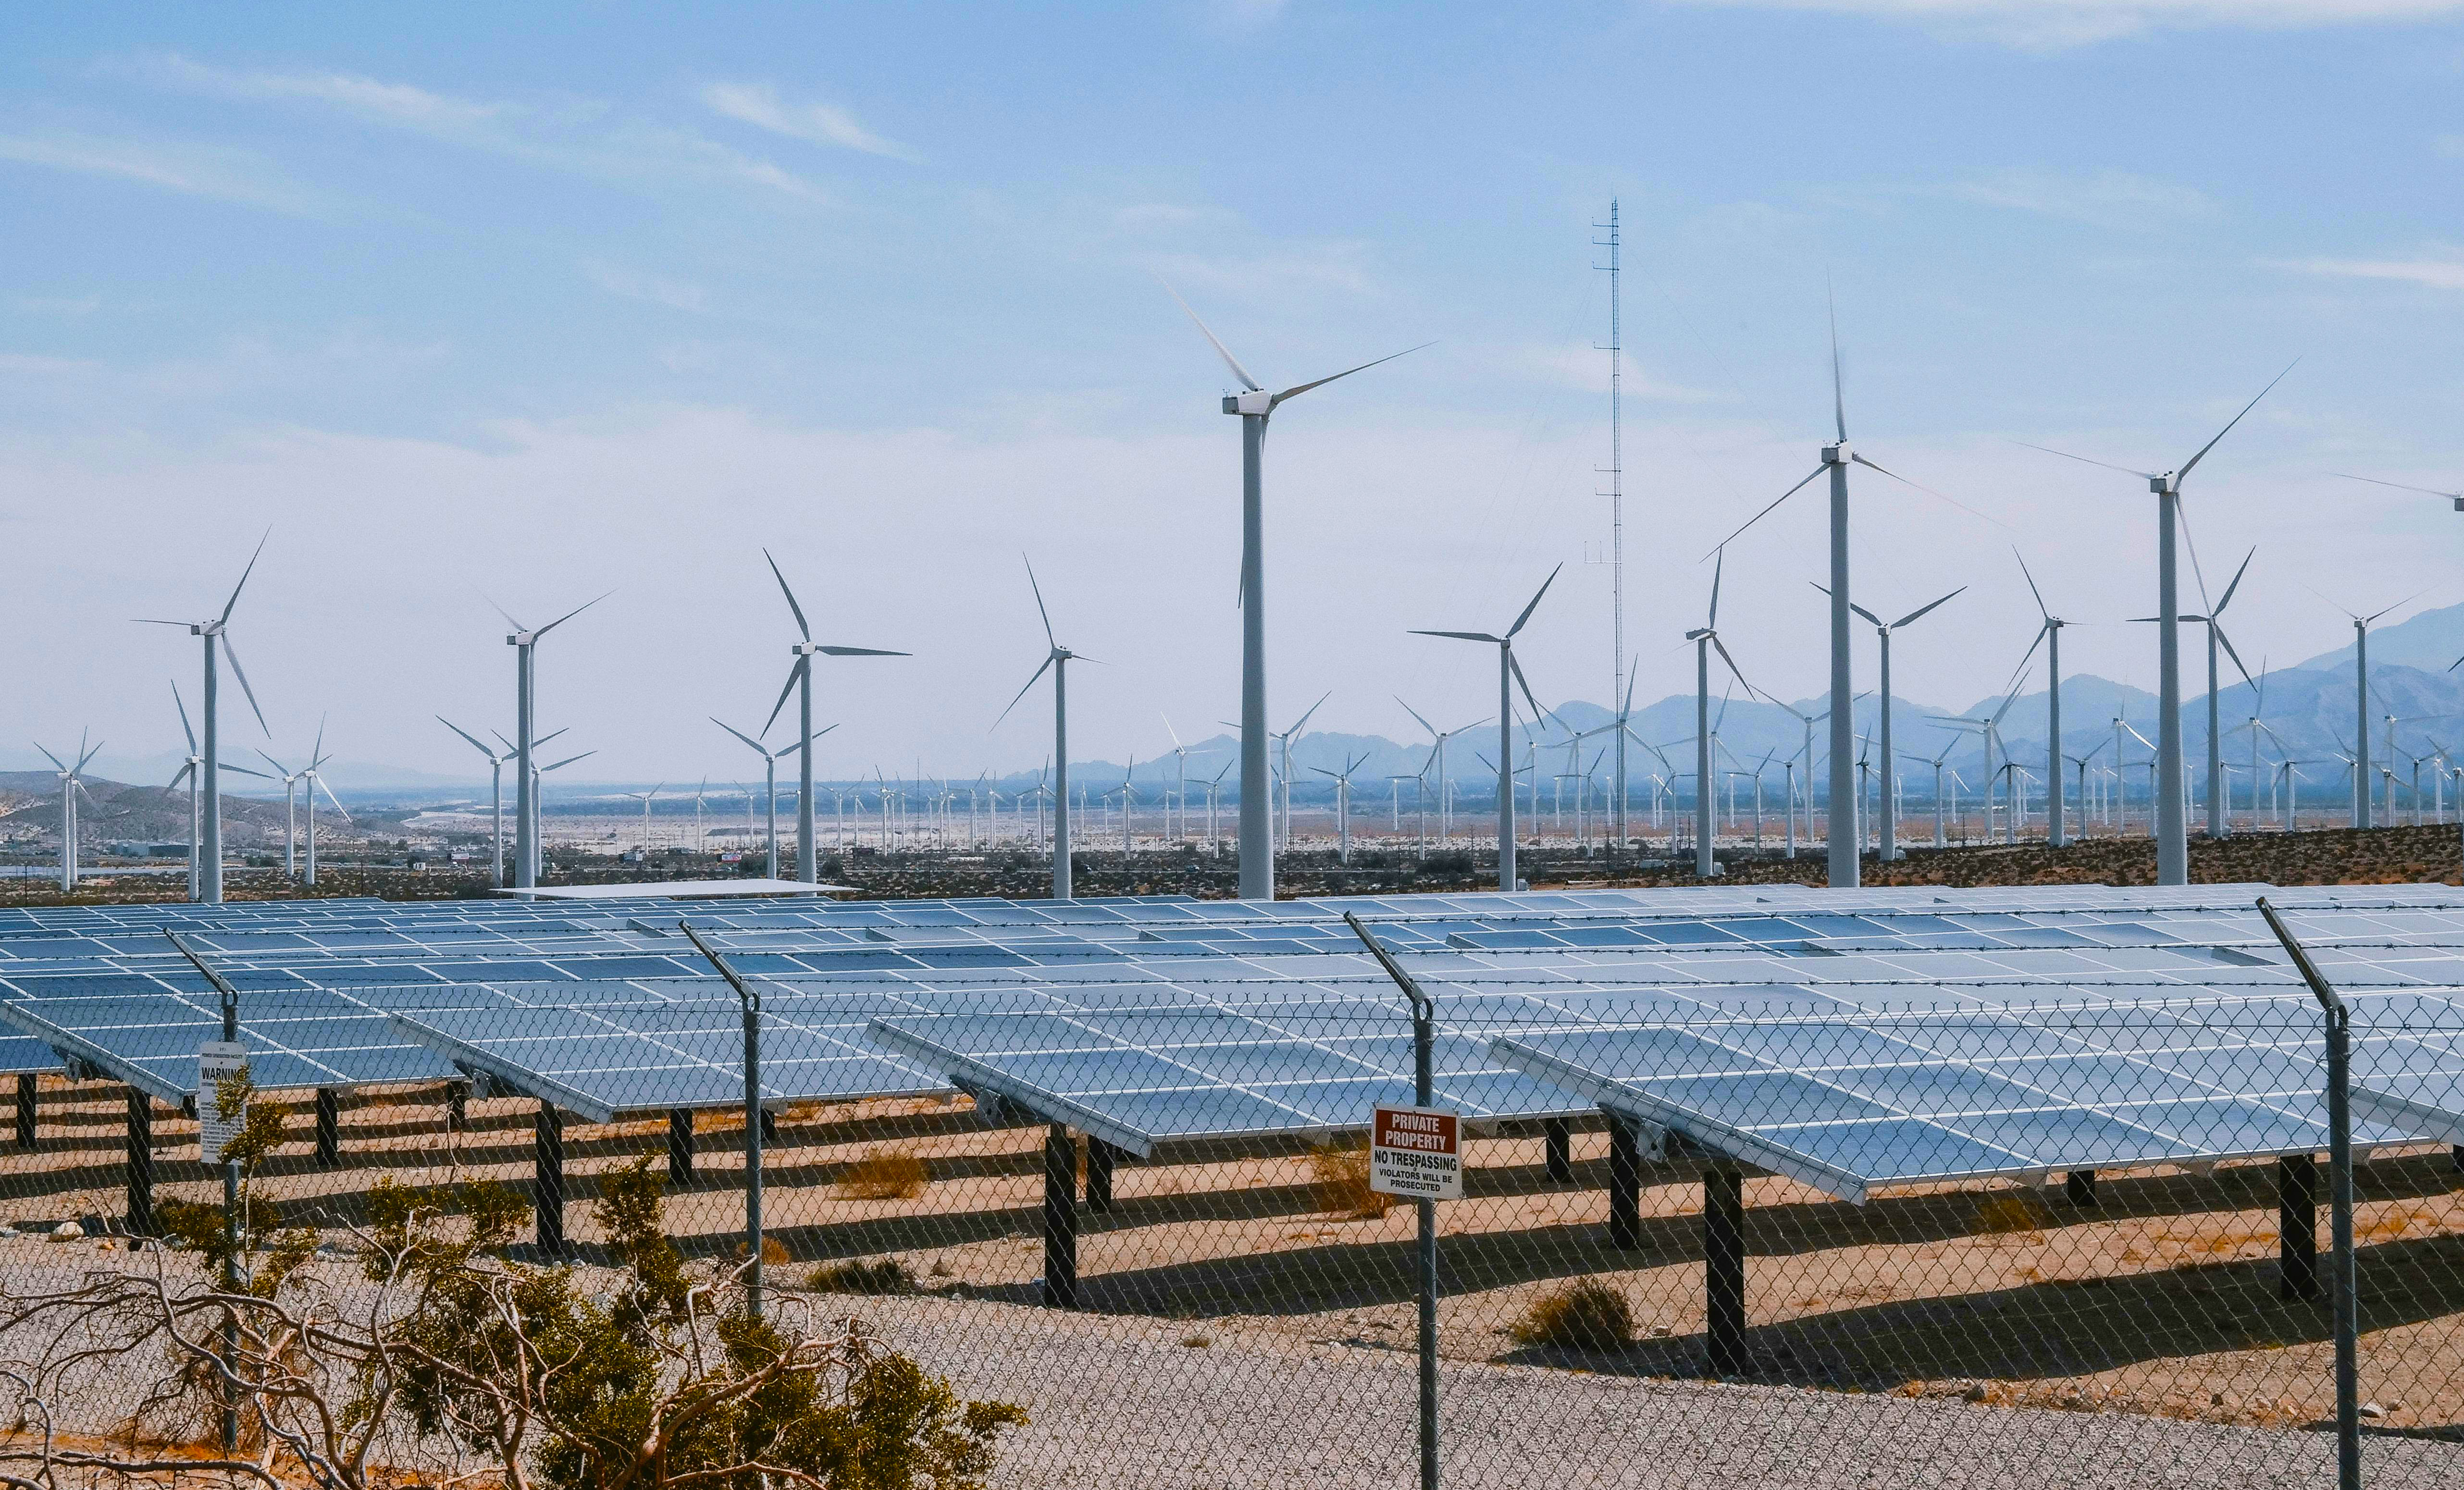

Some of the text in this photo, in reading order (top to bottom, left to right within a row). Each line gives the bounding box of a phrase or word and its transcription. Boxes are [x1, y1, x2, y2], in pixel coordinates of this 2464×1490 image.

[1392, 1114, 1439, 1132] PRIVATE
[1386, 1130, 1446, 1150] PROPERTY
[1374, 1150, 1457, 1171] NO TRESPASSING
[1379, 1168, 1420, 1180] VIOLATORS
[1423, 1173, 1440, 1182] WILL
[1391, 1180, 1440, 1192] PROSECUTED
